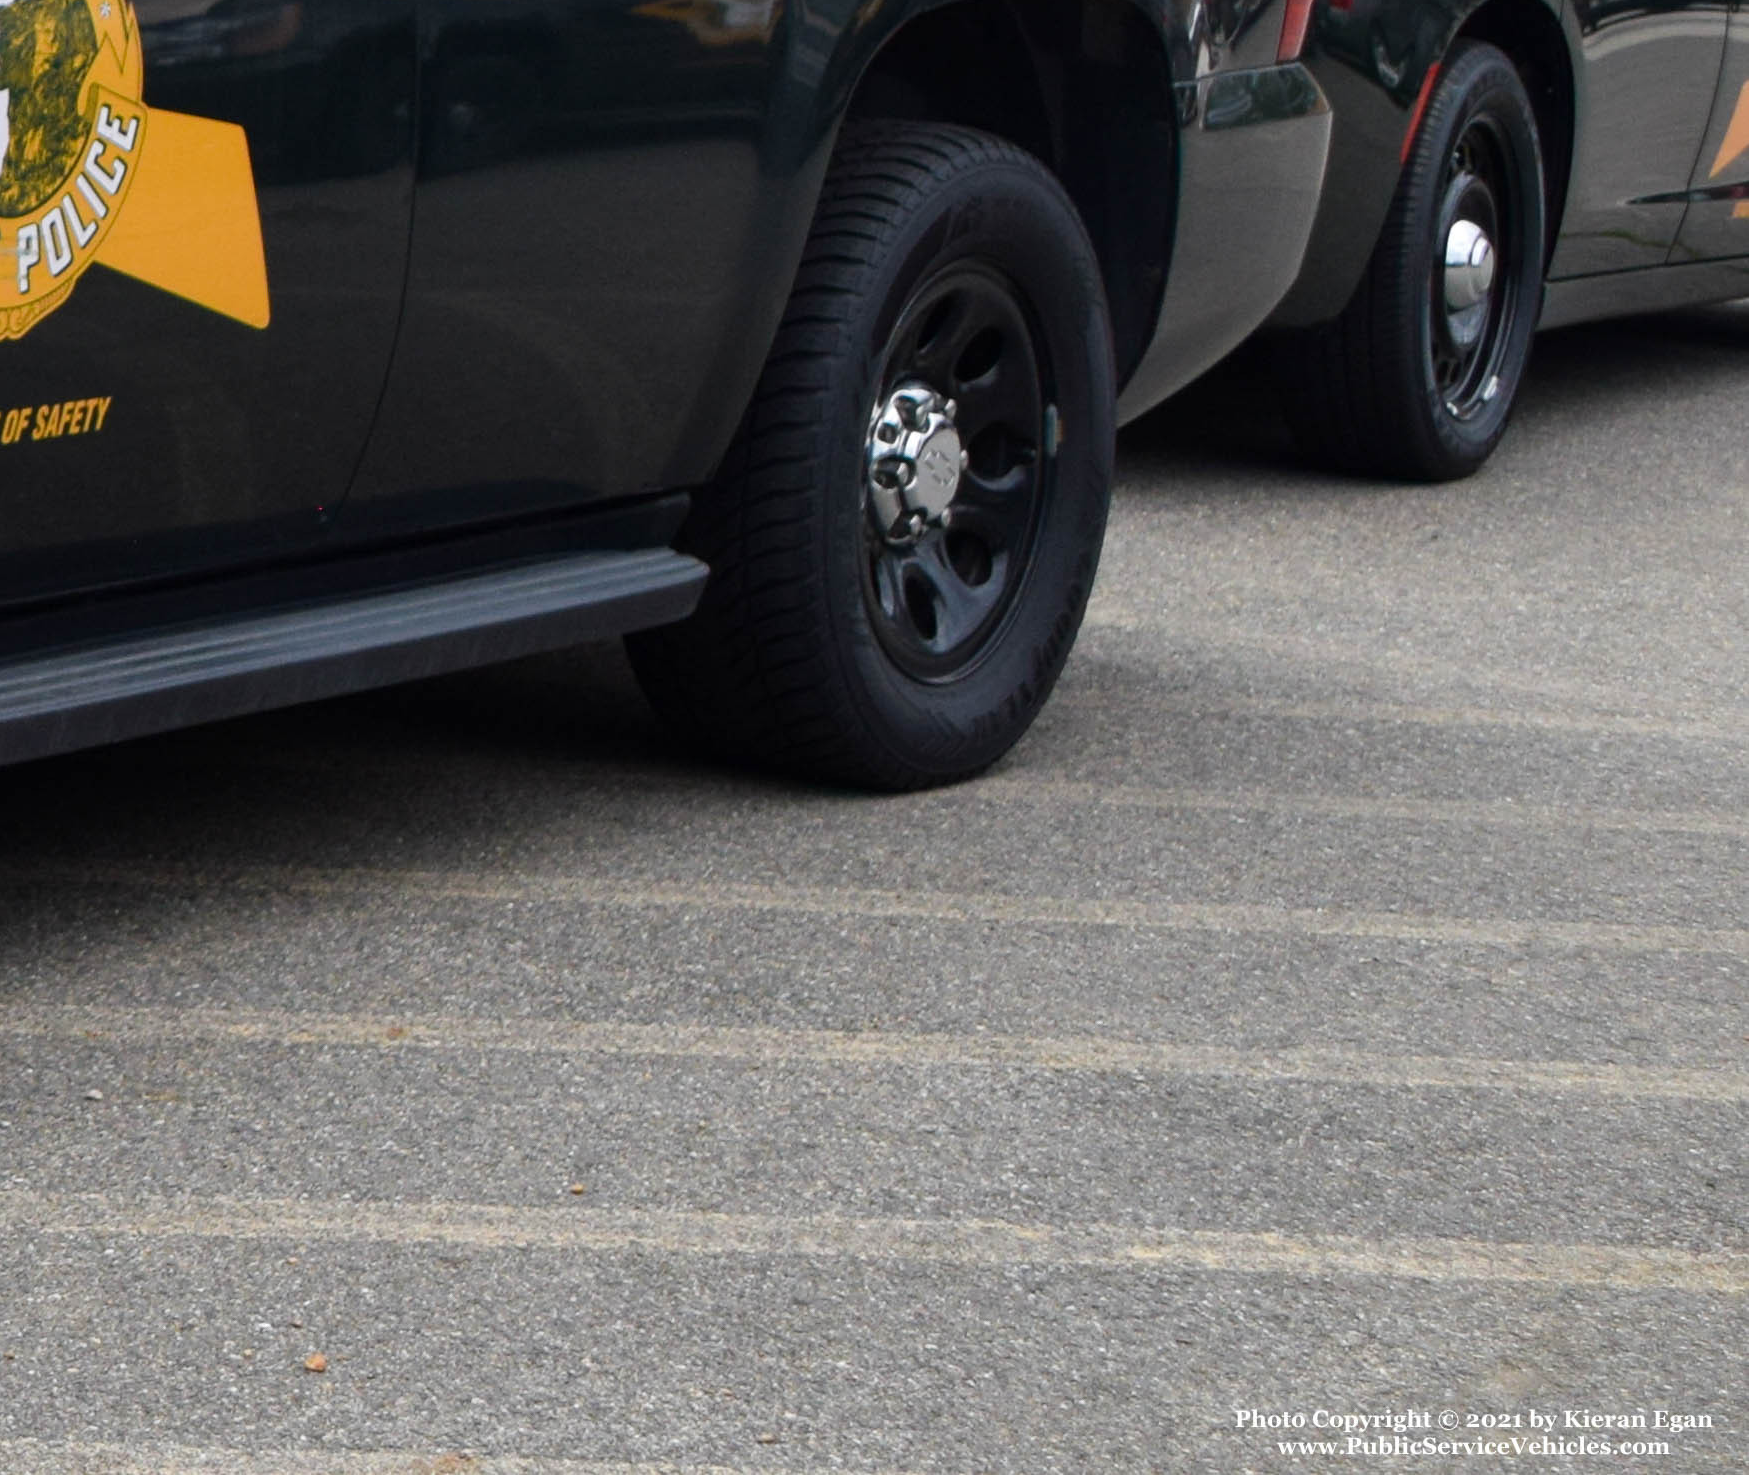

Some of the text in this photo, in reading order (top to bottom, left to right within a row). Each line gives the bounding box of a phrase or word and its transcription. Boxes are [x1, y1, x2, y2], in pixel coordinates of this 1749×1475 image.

[16, 105, 139, 293] POLICE
[1, 407, 33, 442] OF
[32, 396, 113, 439] SAFETY
